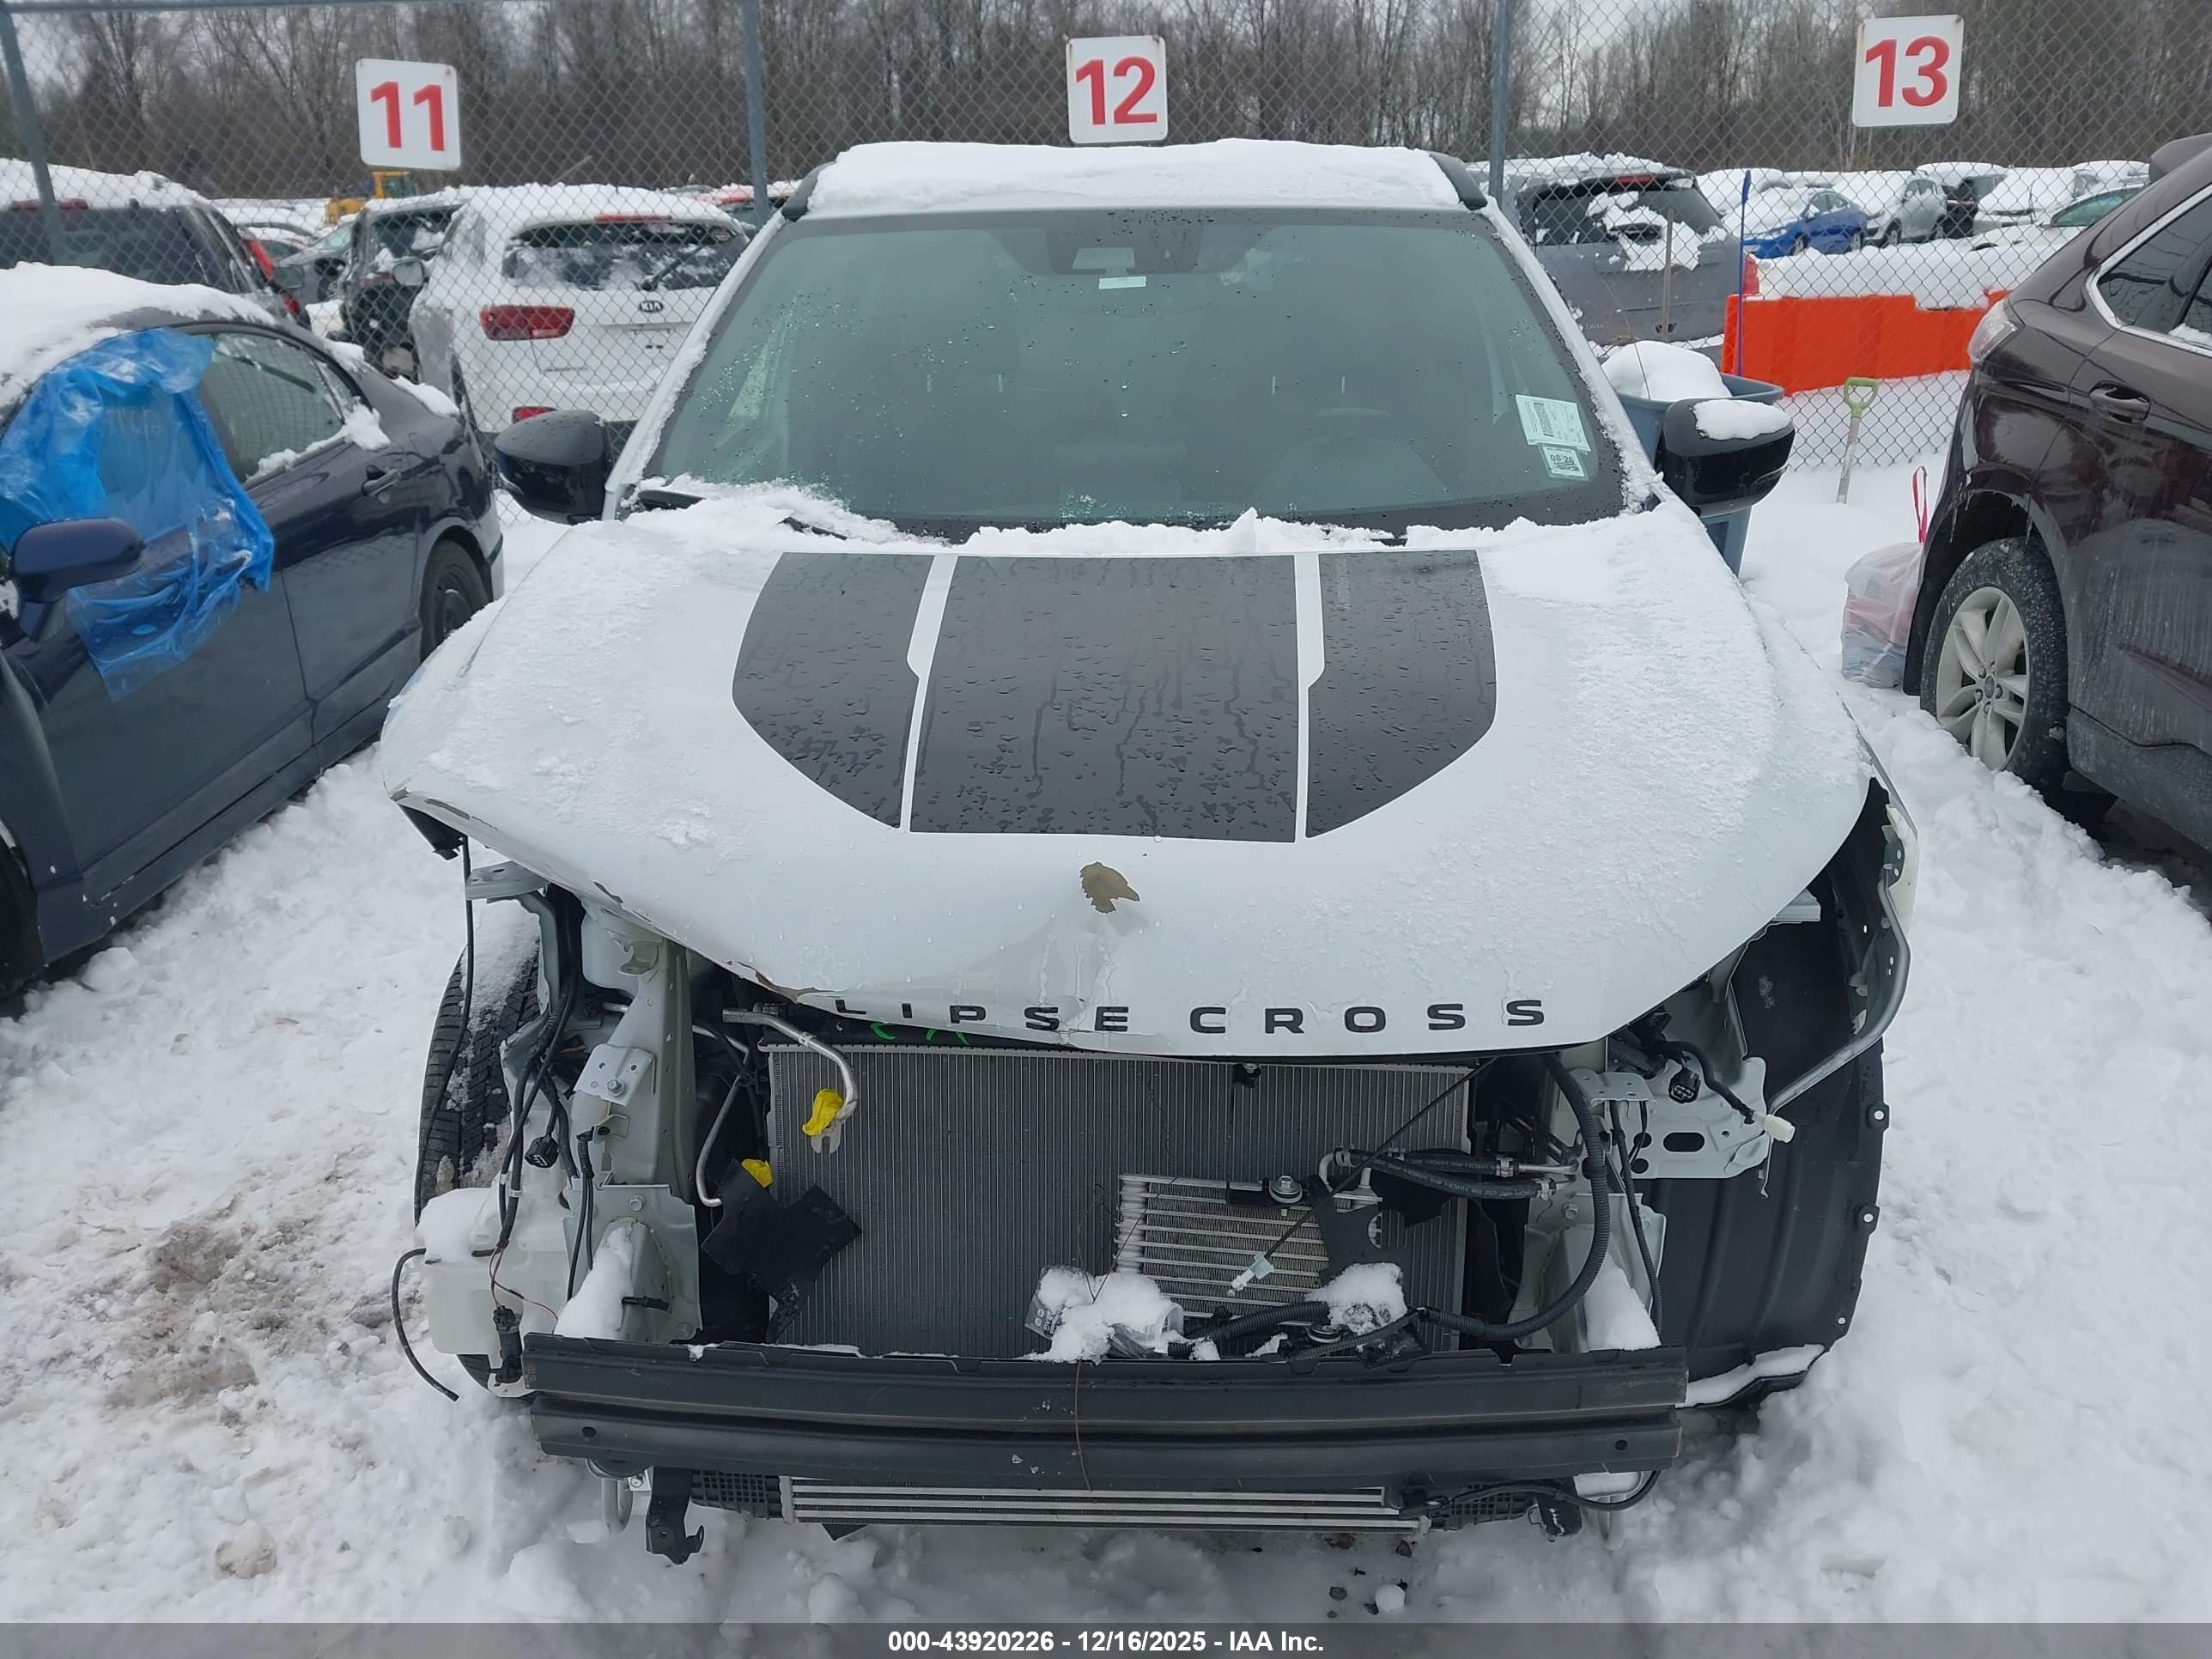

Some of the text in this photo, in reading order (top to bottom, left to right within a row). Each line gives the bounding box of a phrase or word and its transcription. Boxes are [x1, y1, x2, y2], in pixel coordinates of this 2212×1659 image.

[1075, 56, 1158, 126] 12
[1864, 35, 1950, 108] 13
[370, 81, 445, 152] 11
[640, 301, 661, 311] KIA
[1190, 999, 1545, 1034] CROSS
